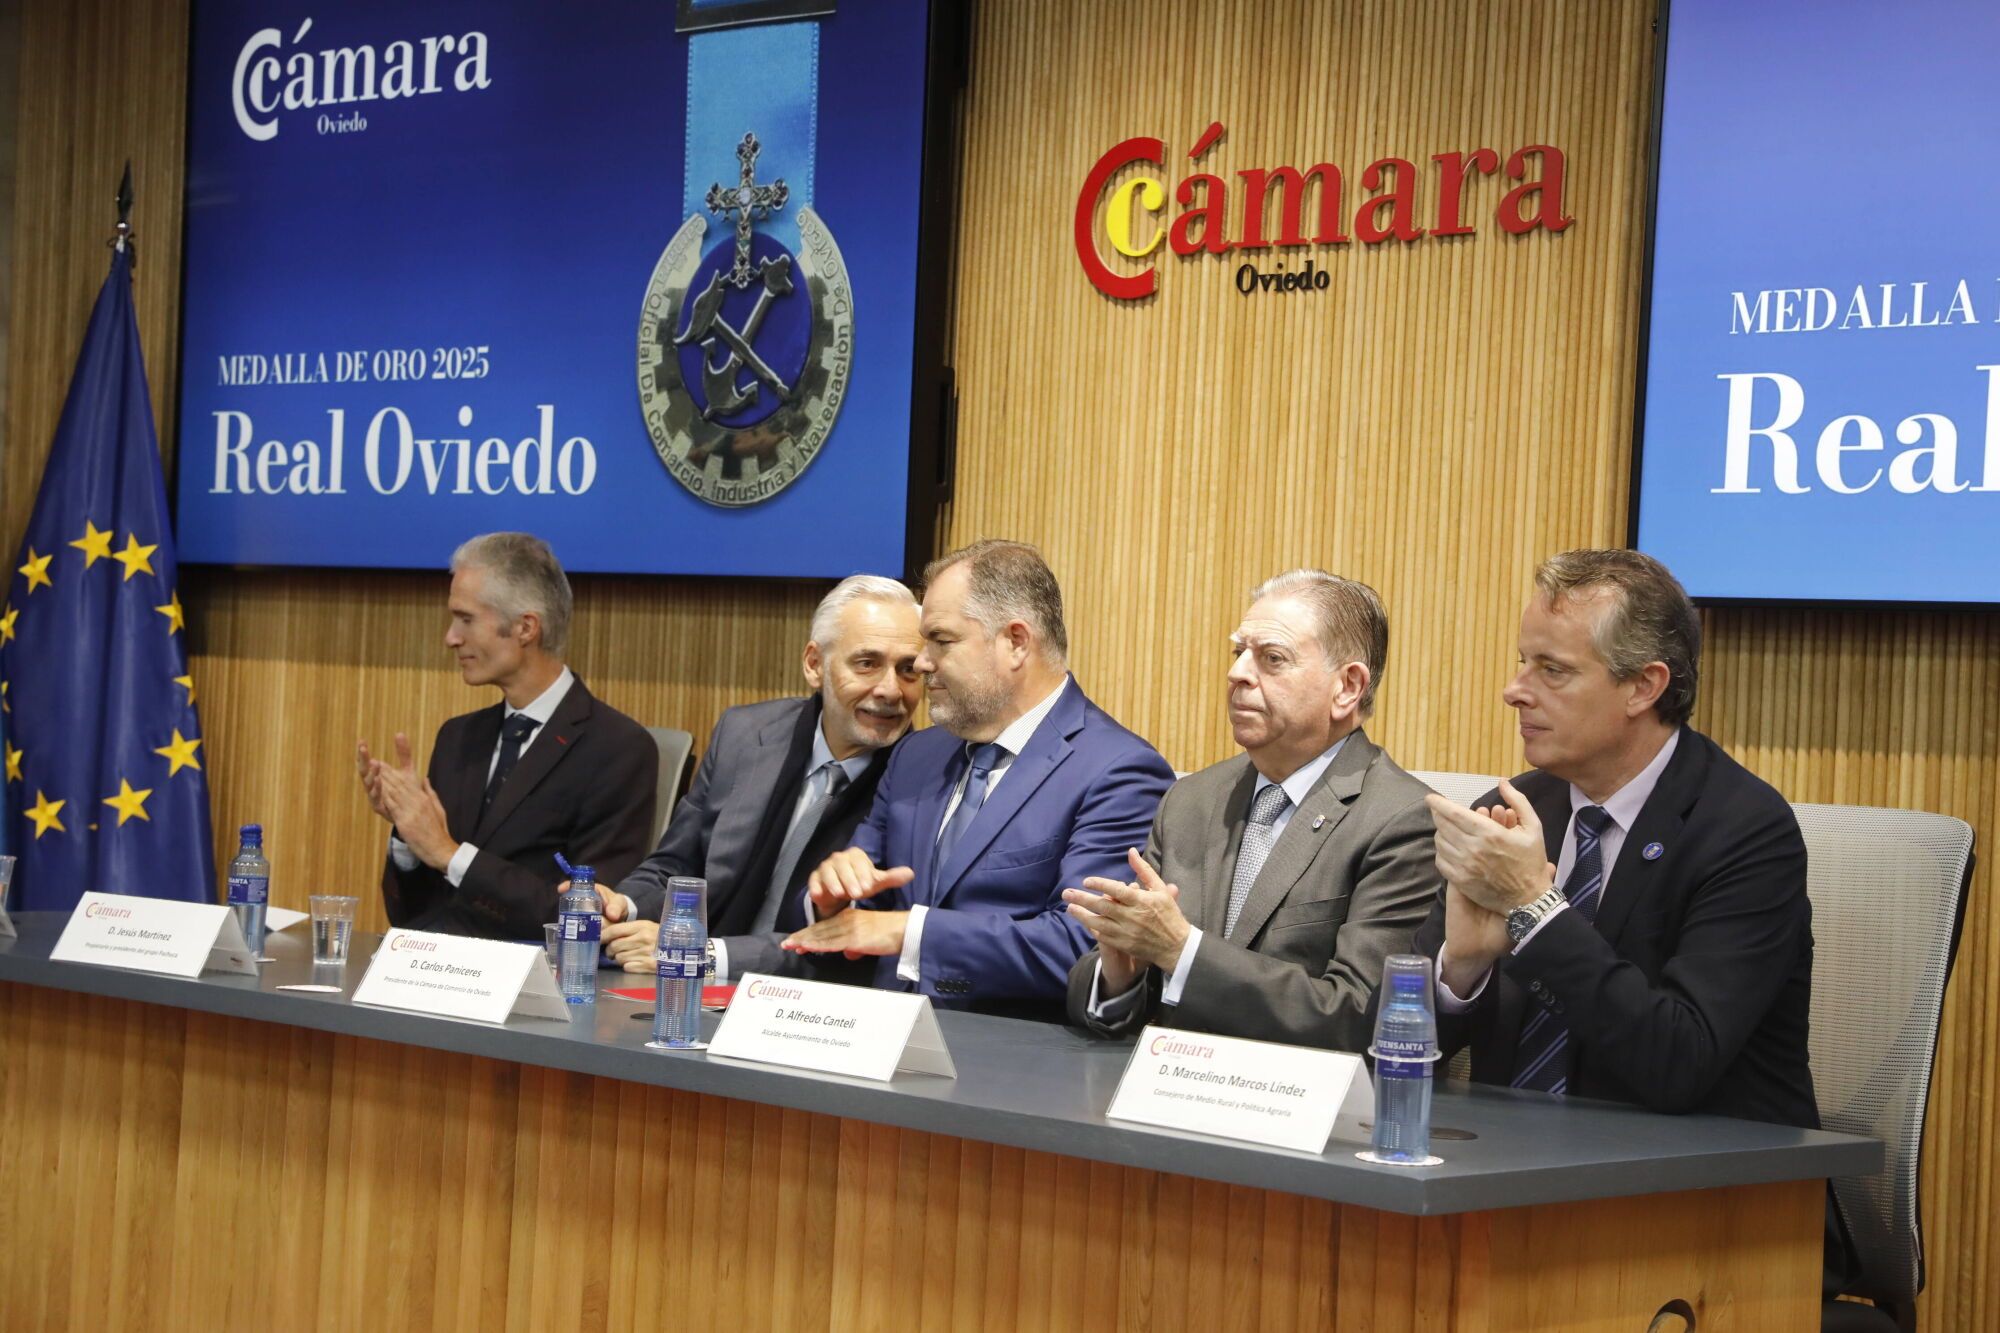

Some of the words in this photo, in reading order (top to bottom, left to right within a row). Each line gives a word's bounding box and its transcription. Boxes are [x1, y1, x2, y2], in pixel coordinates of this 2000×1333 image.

[317, 111, 367, 135] Oviedo
[1236, 260, 1330, 294] Oviedo
[1729, 279, 1980, 335] MEDALLA
[218, 352, 330, 386] MEDALLA
[335, 351, 368, 382] DE
[373, 348, 426, 381] ORO
[432, 345, 490, 380] 2025
[1710, 364, 2000, 494] Real
[209, 408, 347, 495] Real
[364, 405, 597, 496] Oviedo
[108, 926, 116, 935] D.
[410, 959, 418, 969] D.
[420, 960, 444, 973] Carlos
[445, 964, 482, 978] Paniceres
[775, 1009, 785, 1020] D.
[787, 1011, 822, 1025] Alfredo
[823, 1016, 856, 1029] Canteli
[1159, 1064, 1169, 1076] D.
[1172, 1066, 1226, 1085] Marcelino
[1228, 1075, 1268, 1091] Marcos
[1153, 1088, 1185, 1099] Consejero
